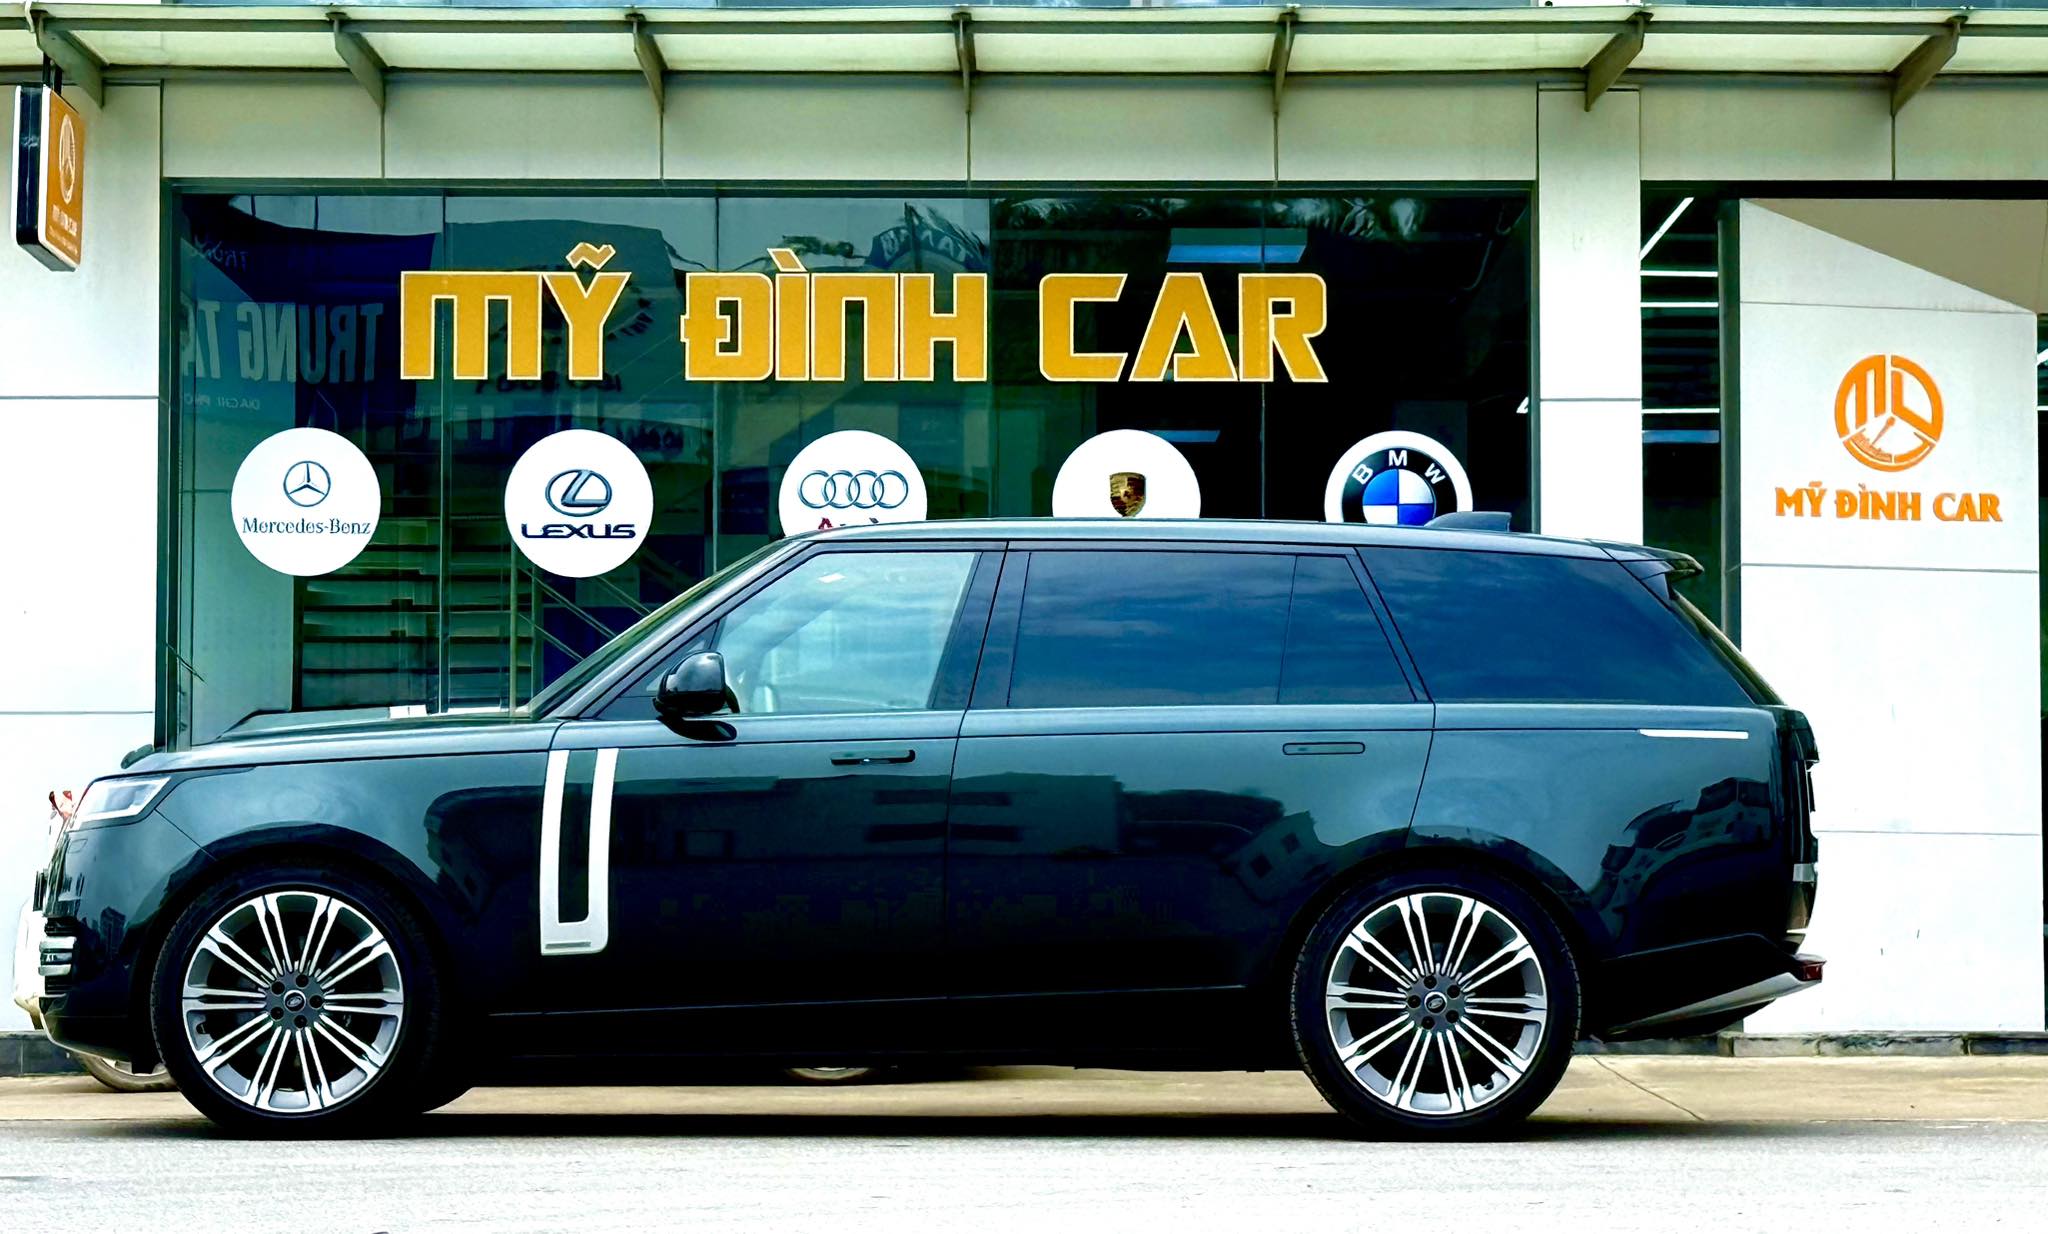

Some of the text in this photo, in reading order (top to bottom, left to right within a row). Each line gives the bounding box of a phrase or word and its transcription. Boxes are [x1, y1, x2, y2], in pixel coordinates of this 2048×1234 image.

[401, 242, 1329, 382] MỸ ĐÌNH CAR
[1352, 449, 1446, 485] BMW
[1932, 492, 2003, 522] CAR
[242, 517, 372, 537] Mercedes-Benz
[521, 523, 636, 539] LEXUS
